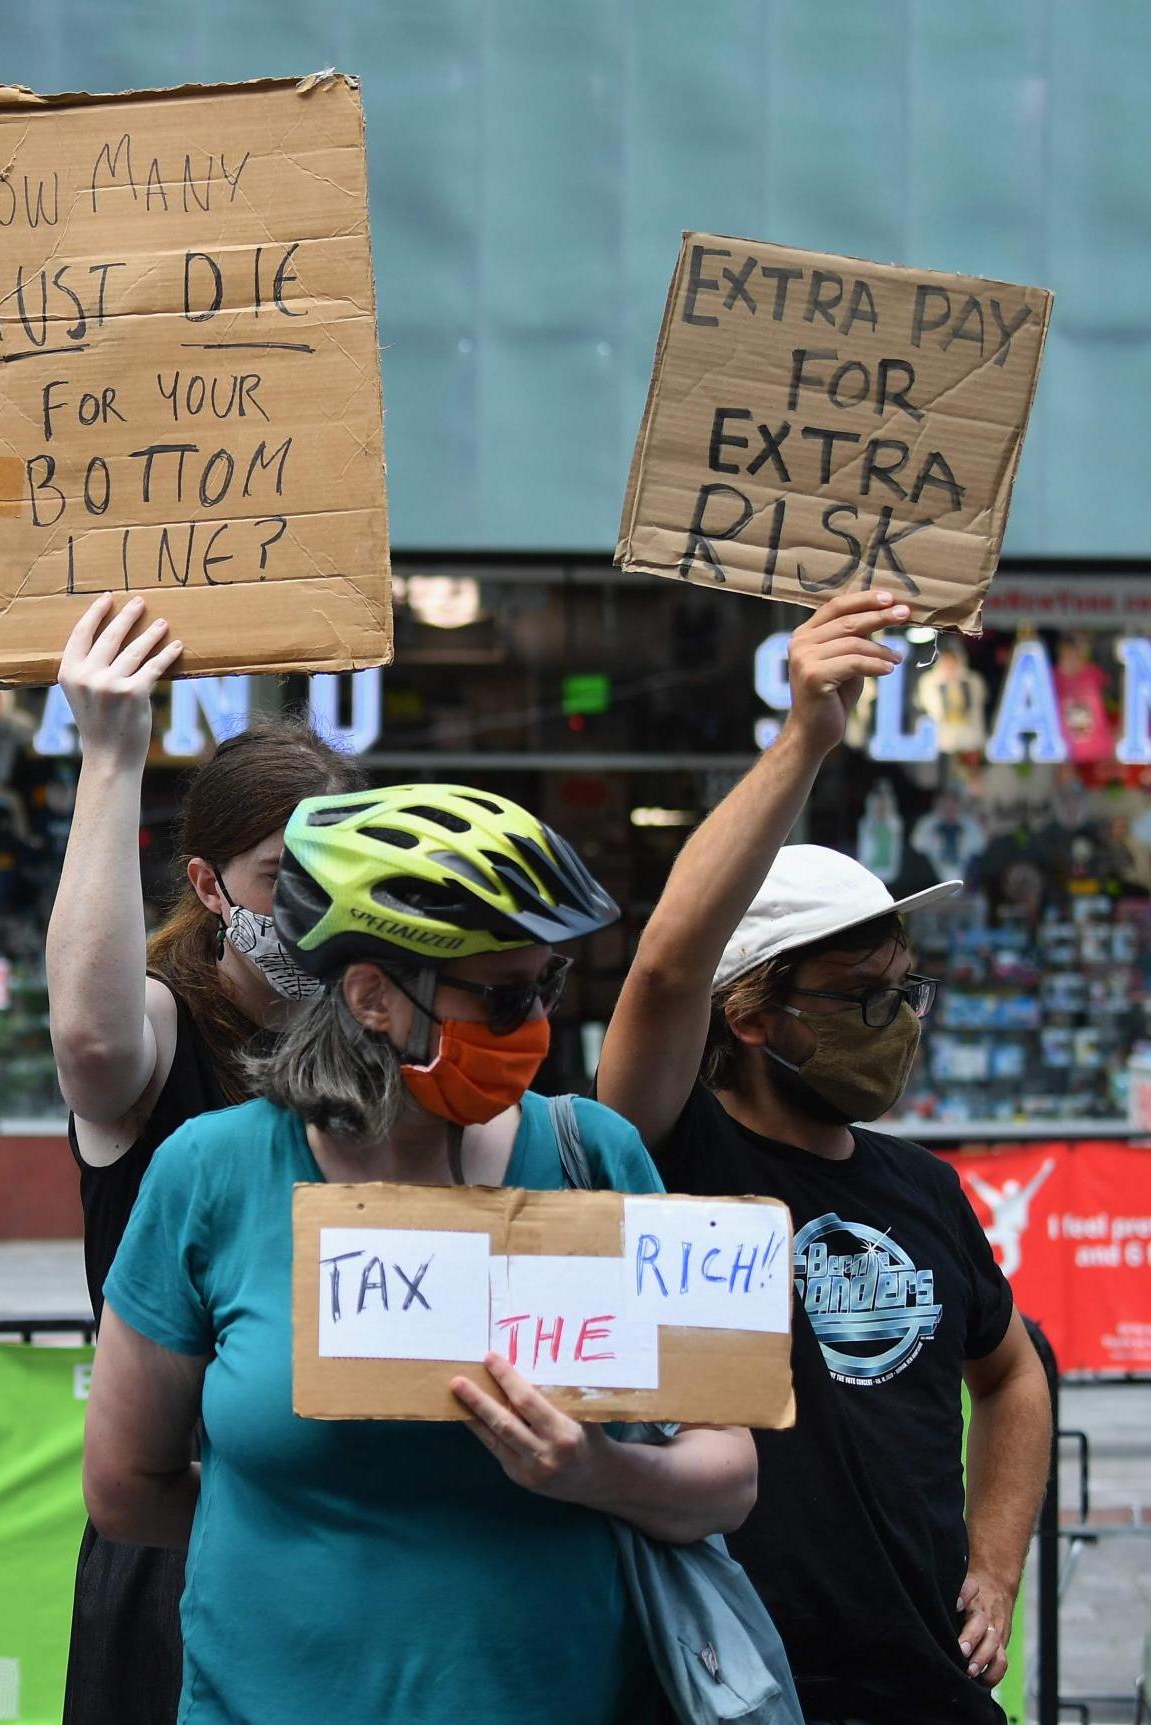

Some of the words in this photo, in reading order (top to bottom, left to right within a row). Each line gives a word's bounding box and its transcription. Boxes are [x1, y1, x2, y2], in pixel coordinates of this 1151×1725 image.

[93, 133, 250, 213] MANY
[183, 243, 307, 322] DIE
[681, 245, 878, 335] EXTRA
[911, 285, 1032, 368] PAY
[43, 381, 126, 441] FOR
[157, 371, 269, 421] YOUR
[788, 349, 925, 422] FOR
[27, 438, 291, 527] BOTTOM
[709, 408, 966, 512] EXTRA
[67, 515, 287, 597] LINE?
[681, 483, 935, 597] RISK
[349, 907, 466, 950] SPECIALIZED
[320, 1250, 436, 1324] TAX
[496, 1314, 616, 1370] THE
[636, 1231, 786, 1298] RICH!!
[794, 1256, 934, 1316] anders
